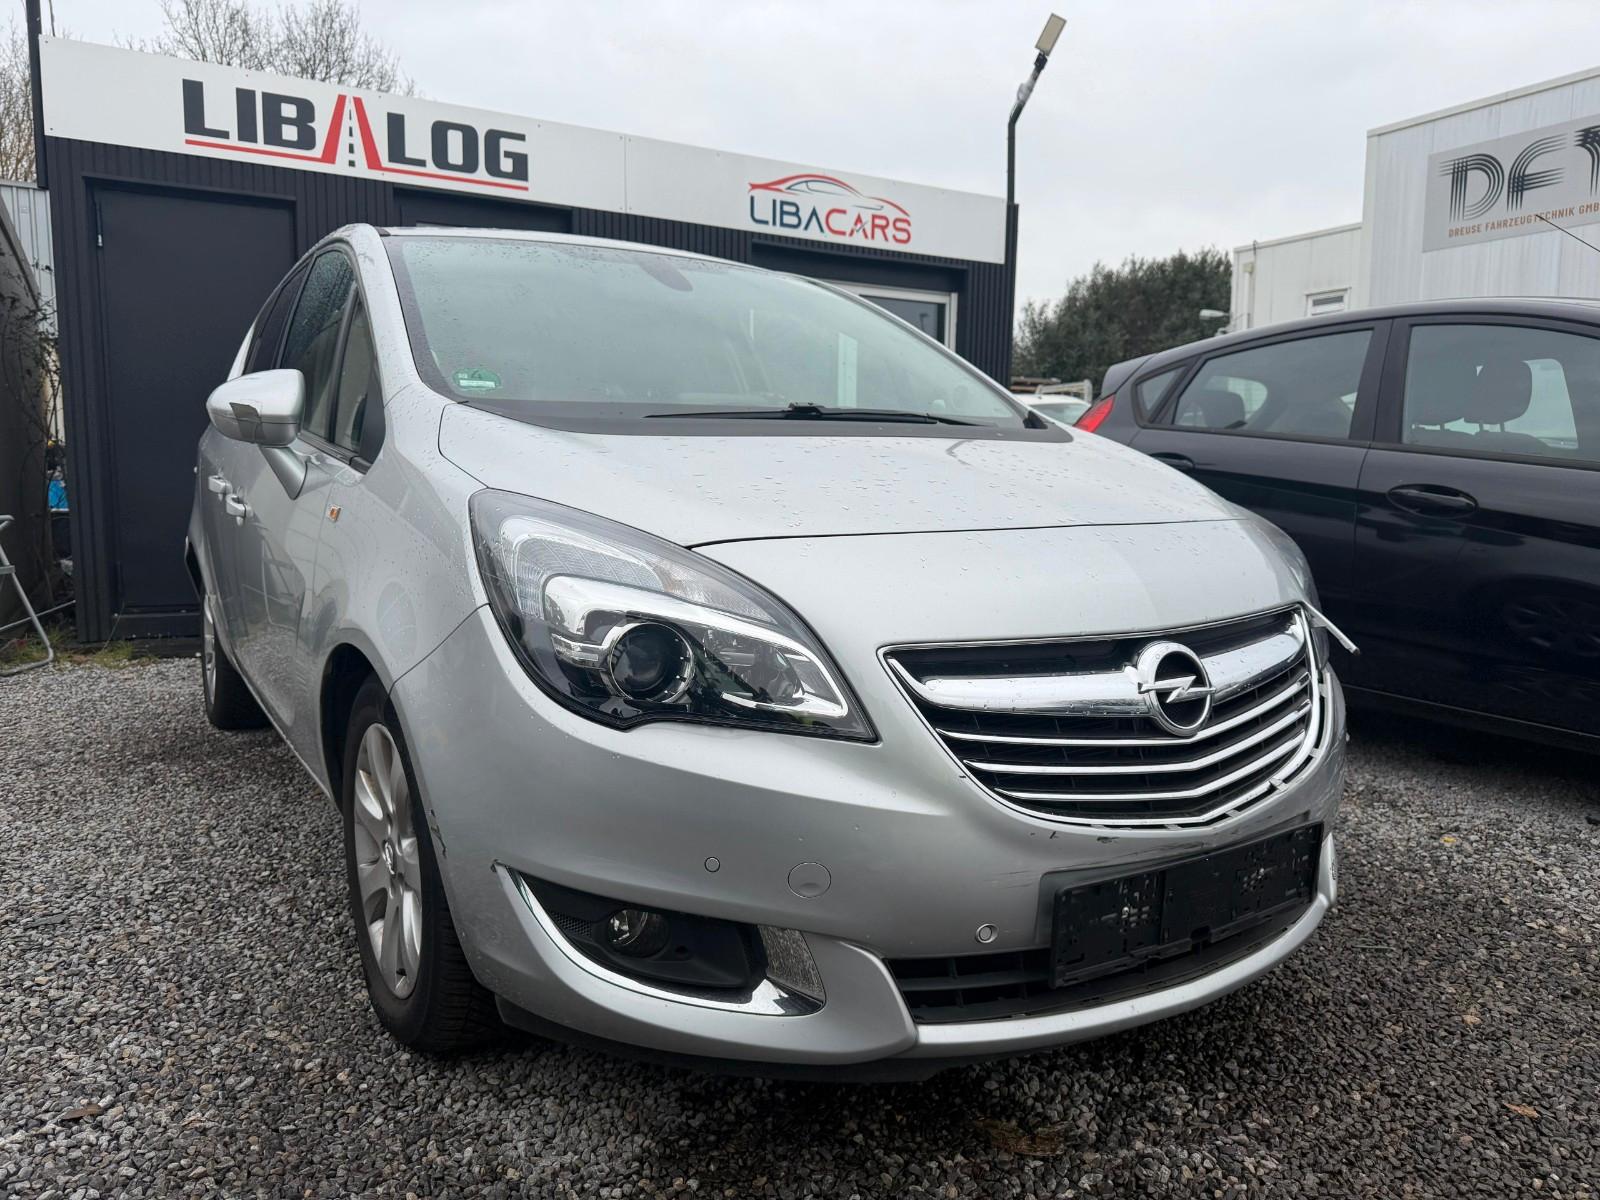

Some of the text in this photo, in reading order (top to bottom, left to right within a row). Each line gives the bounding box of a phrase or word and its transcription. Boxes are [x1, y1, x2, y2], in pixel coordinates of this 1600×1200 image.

[182, 78, 529, 182] LIBALOG
[750, 195, 912, 245] LIBACARS
[1448, 223, 1483, 238] DREUSE
[1485, 207, 1575, 232] FAHRZEUGTECHNIK
